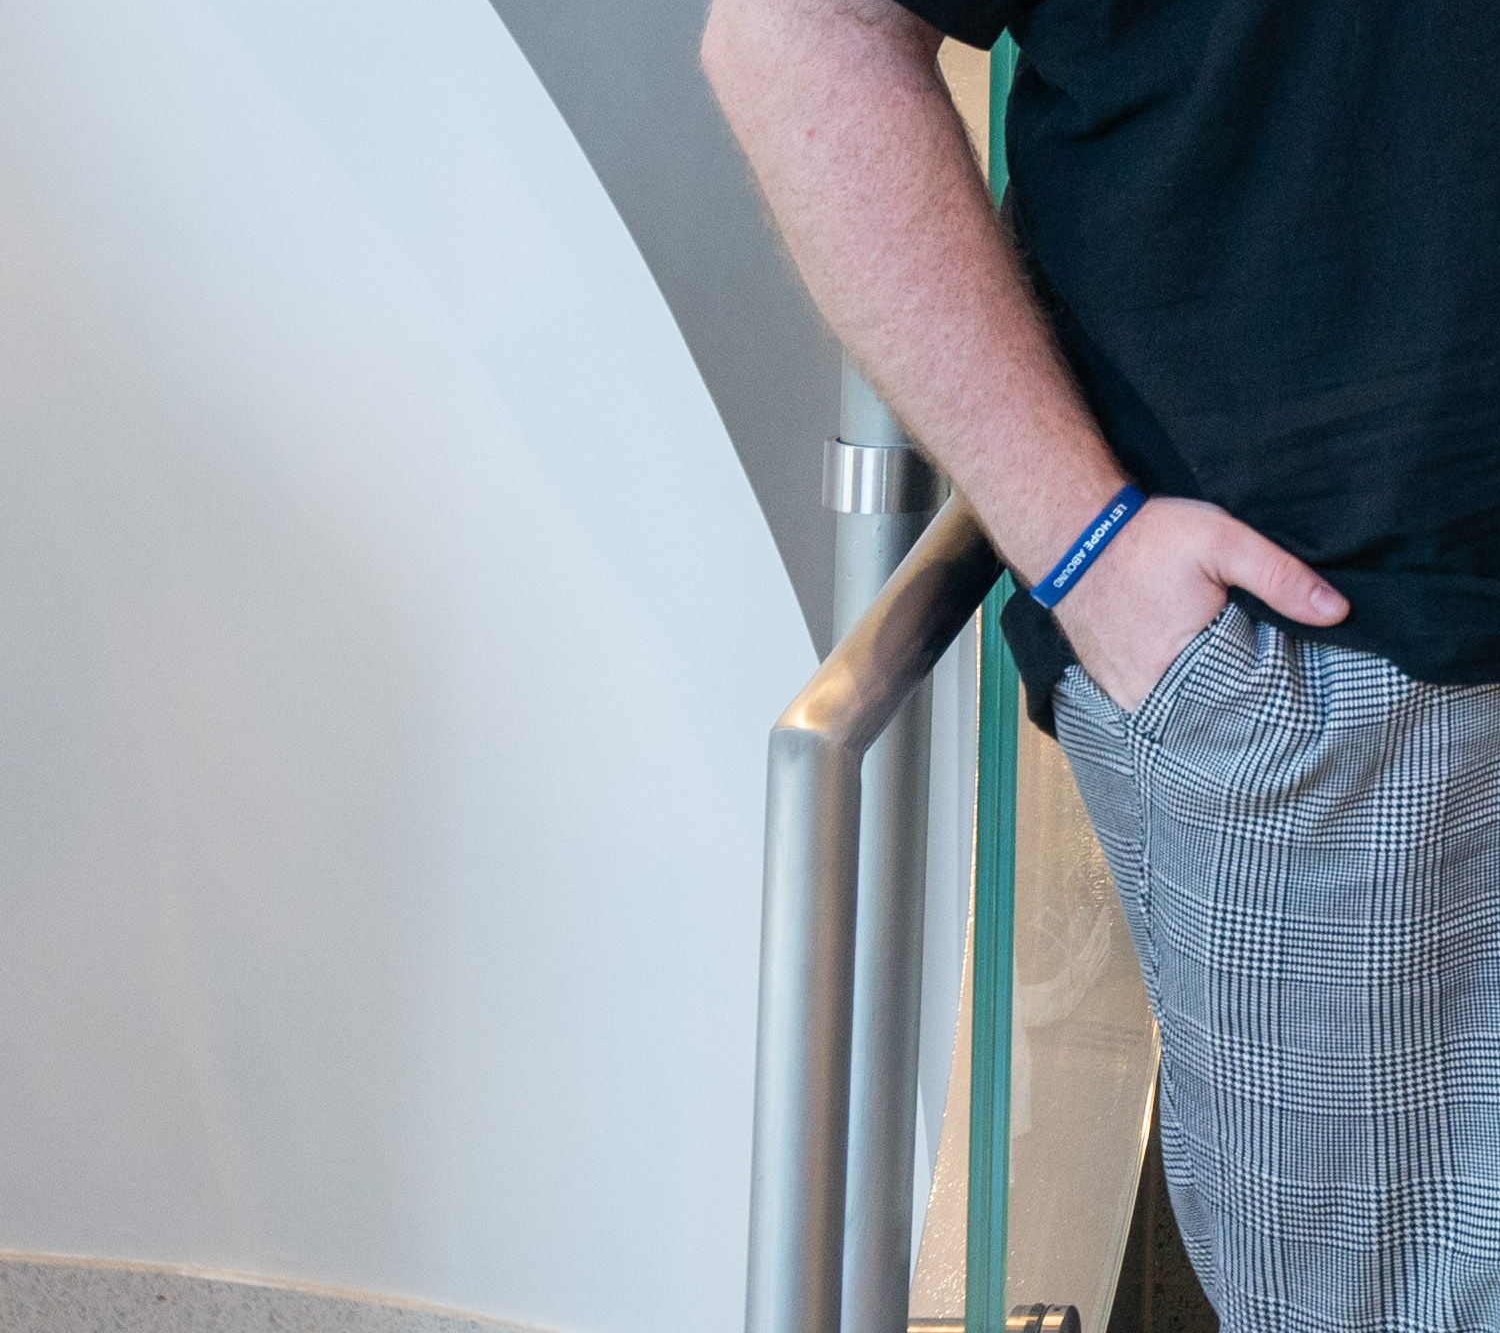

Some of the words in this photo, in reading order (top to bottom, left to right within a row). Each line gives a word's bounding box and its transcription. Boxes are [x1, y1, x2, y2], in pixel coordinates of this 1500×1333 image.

[1109, 503, 1128, 523] LET
[1083, 519, 1112, 551] HOPE
[1053, 548, 1087, 588] ABOUND
